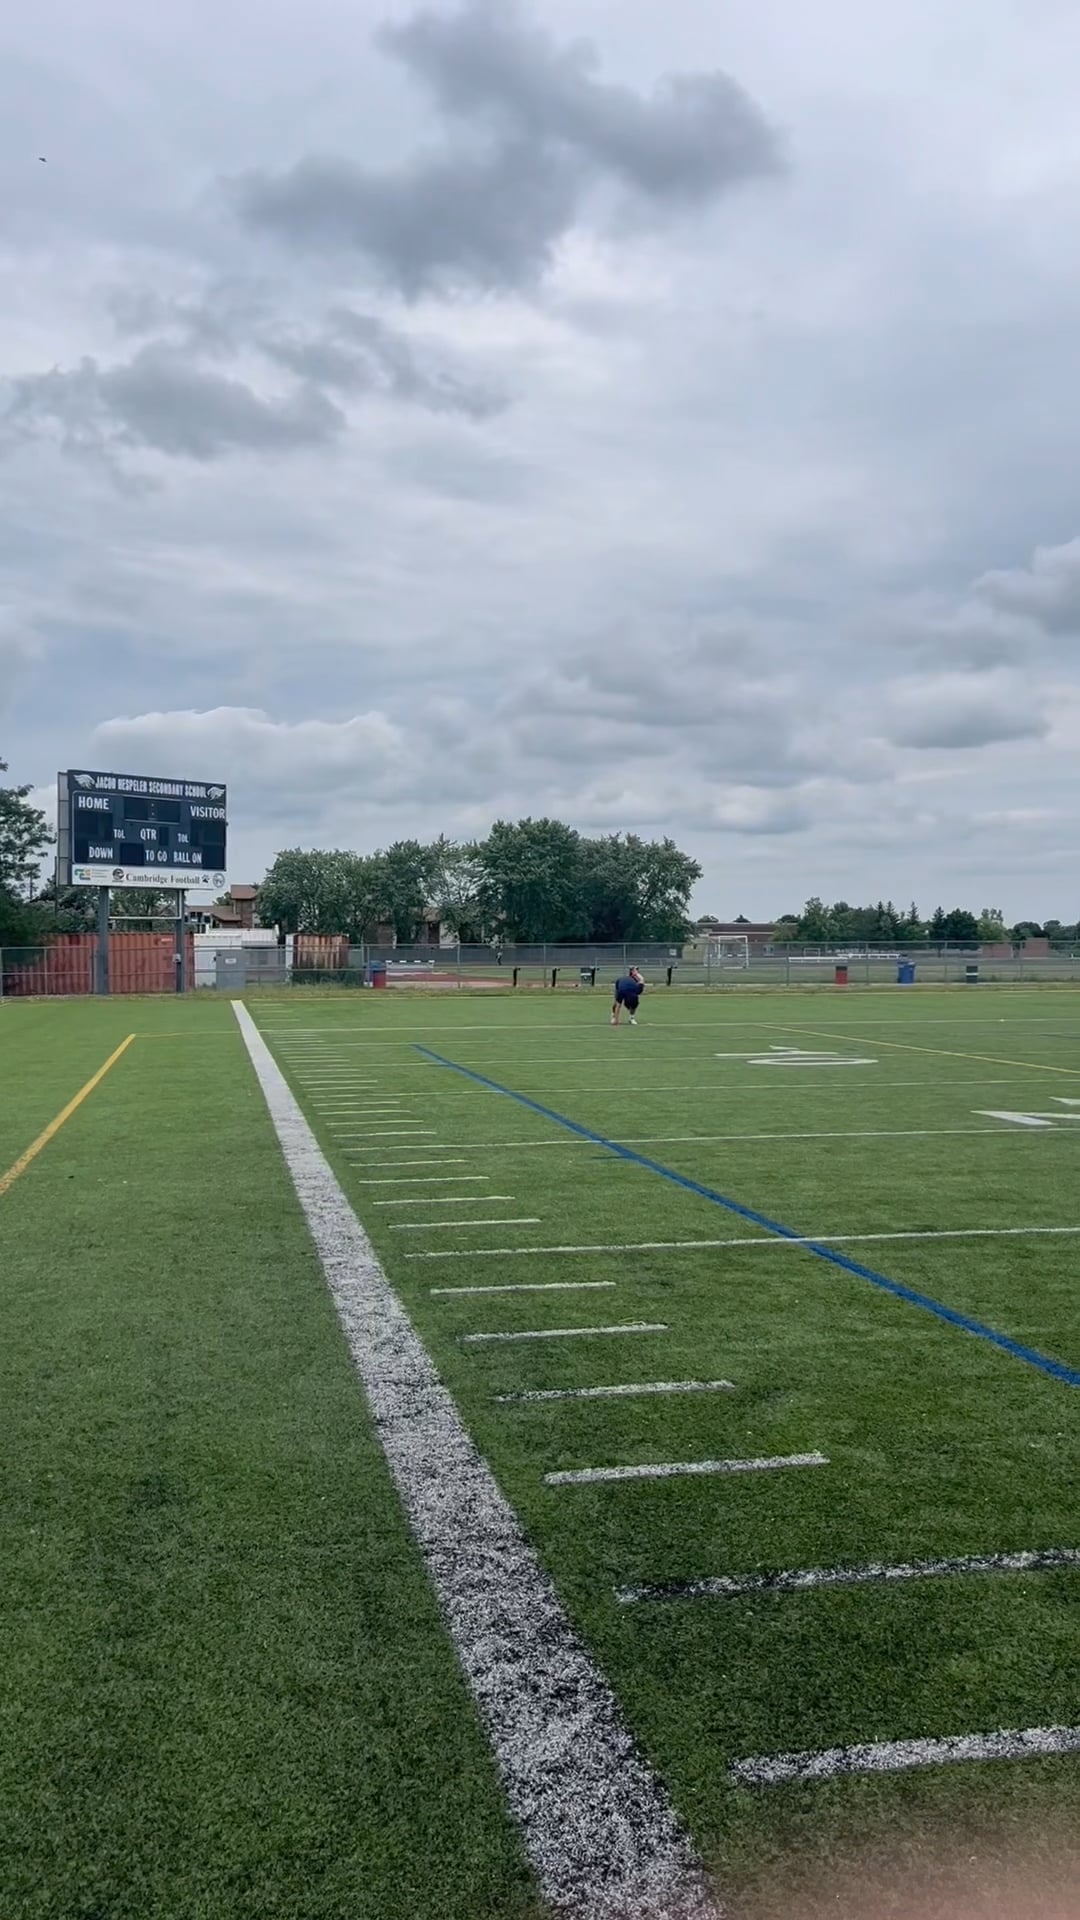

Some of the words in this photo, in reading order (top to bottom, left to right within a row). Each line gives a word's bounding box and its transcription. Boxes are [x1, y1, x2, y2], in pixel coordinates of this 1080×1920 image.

[149, 781, 183, 796] SECONDARY
[184, 785, 207, 799] SCHOOL
[78, 796, 110, 810] HOME
[190, 805, 225, 819] VISITOR
[114, 828, 126, 839] TOL
[140, 828, 157, 841] QTR
[177, 833, 189, 843] TOL
[89, 846, 113, 859] DOWN
[145, 849, 155, 861] TO
[157, 850, 168, 862] GO
[173, 852, 190, 863] BALL
[192, 852, 202, 864] ON
[126, 872, 167, 884] Cambridge
[171, 873, 200, 884] Football
